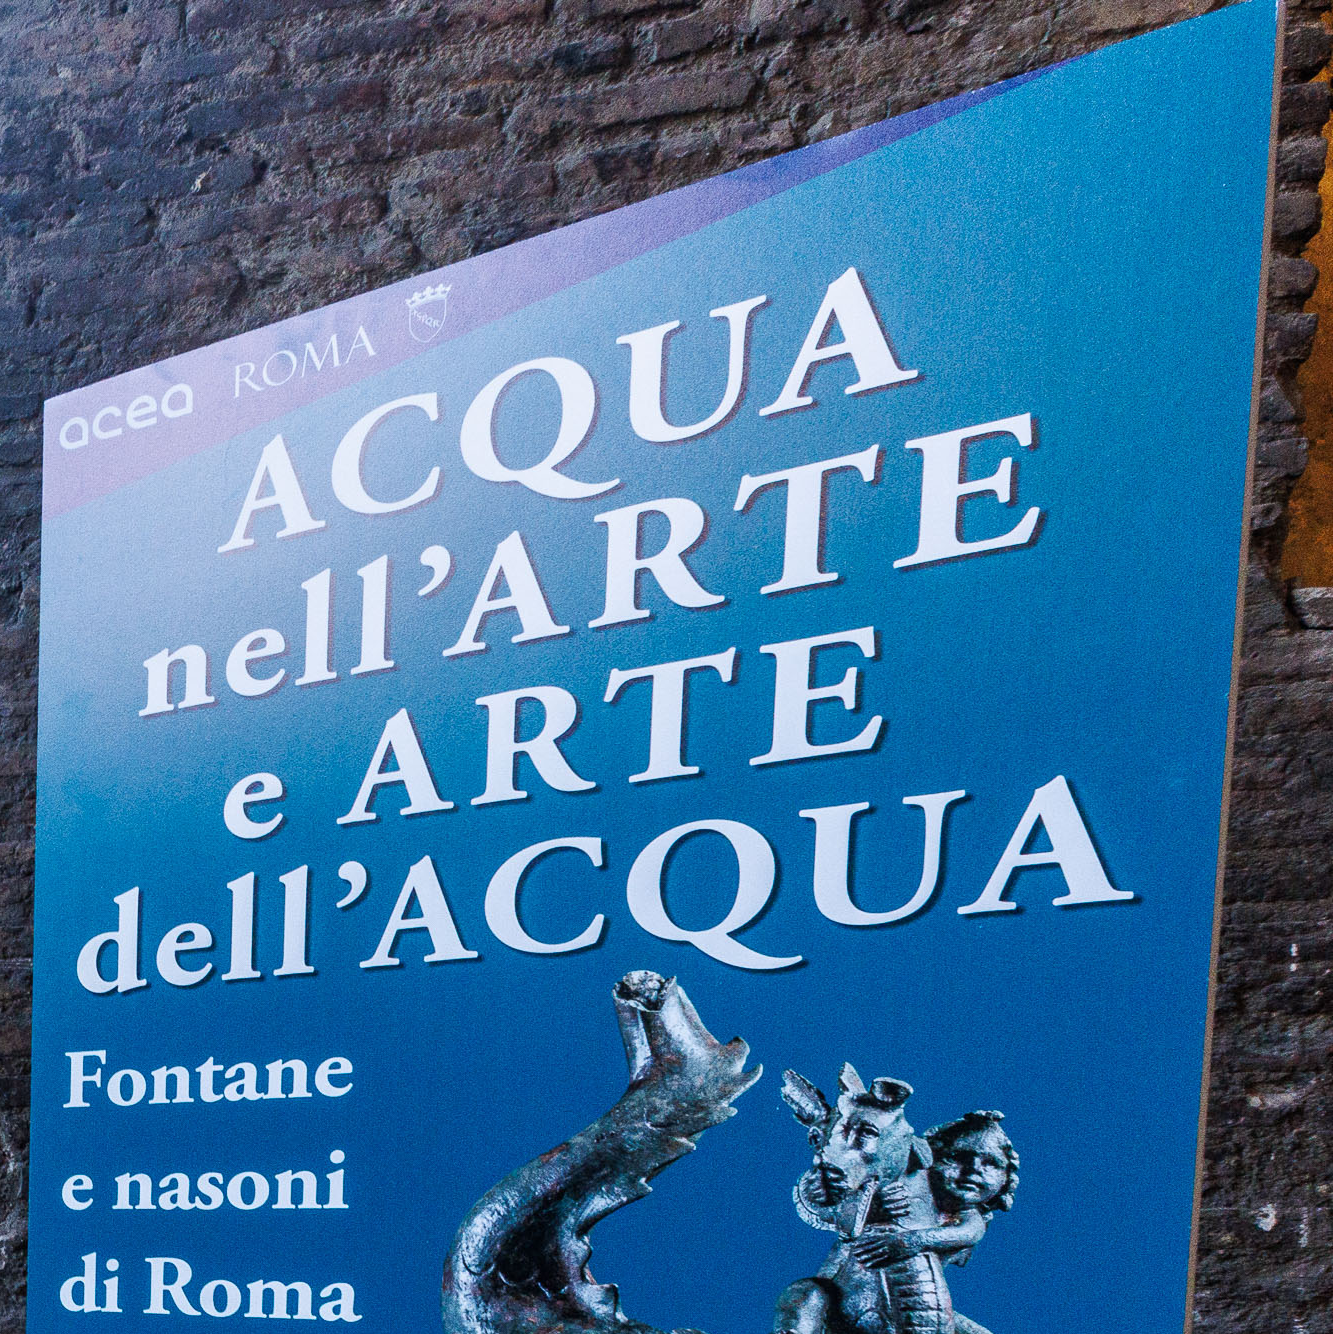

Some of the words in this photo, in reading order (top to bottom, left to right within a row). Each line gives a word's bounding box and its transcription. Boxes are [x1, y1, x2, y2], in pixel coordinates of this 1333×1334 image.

[59, 383, 194, 450] acea
[233, 325, 377, 399] ROMA
[217, 265, 920, 556] ACQUA
[137, 412, 1042, 718] nell’ARTE
[224, 770, 286, 840] e
[336, 625, 886, 826] ARTE
[76, 773, 1136, 996] dell’ACQUA
[63, 1050, 354, 1108] Fontane
[61, 1174, 94, 1211] e
[112, 1150, 349, 1211] nasoni
[59, 1252, 123, 1313] di
[143, 1257, 363, 1322] Roma
